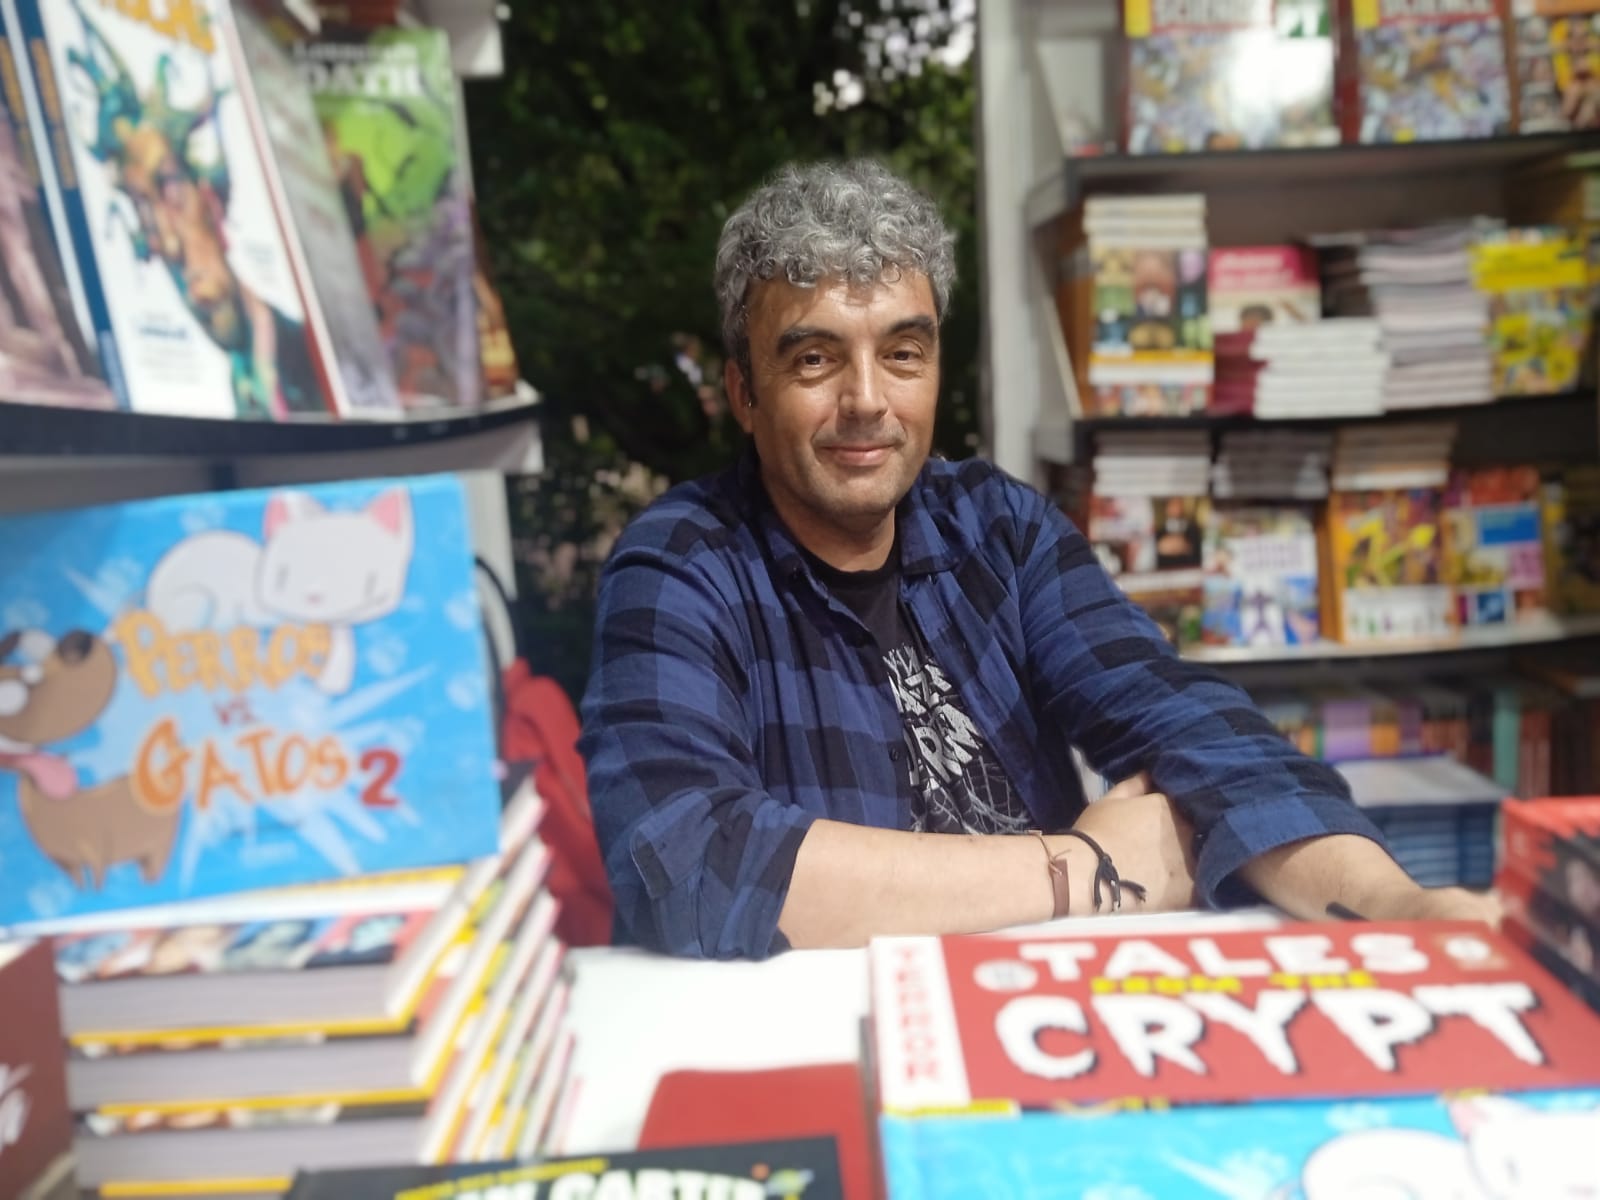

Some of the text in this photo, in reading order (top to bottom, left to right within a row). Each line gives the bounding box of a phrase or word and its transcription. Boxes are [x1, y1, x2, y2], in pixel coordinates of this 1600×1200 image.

[114, 611, 332, 698] PERROS
[134, 716, 402, 812] GATOS 2
[1019, 935, 1429, 980] TALES
[995, 983, 1548, 1081] CRYPT
